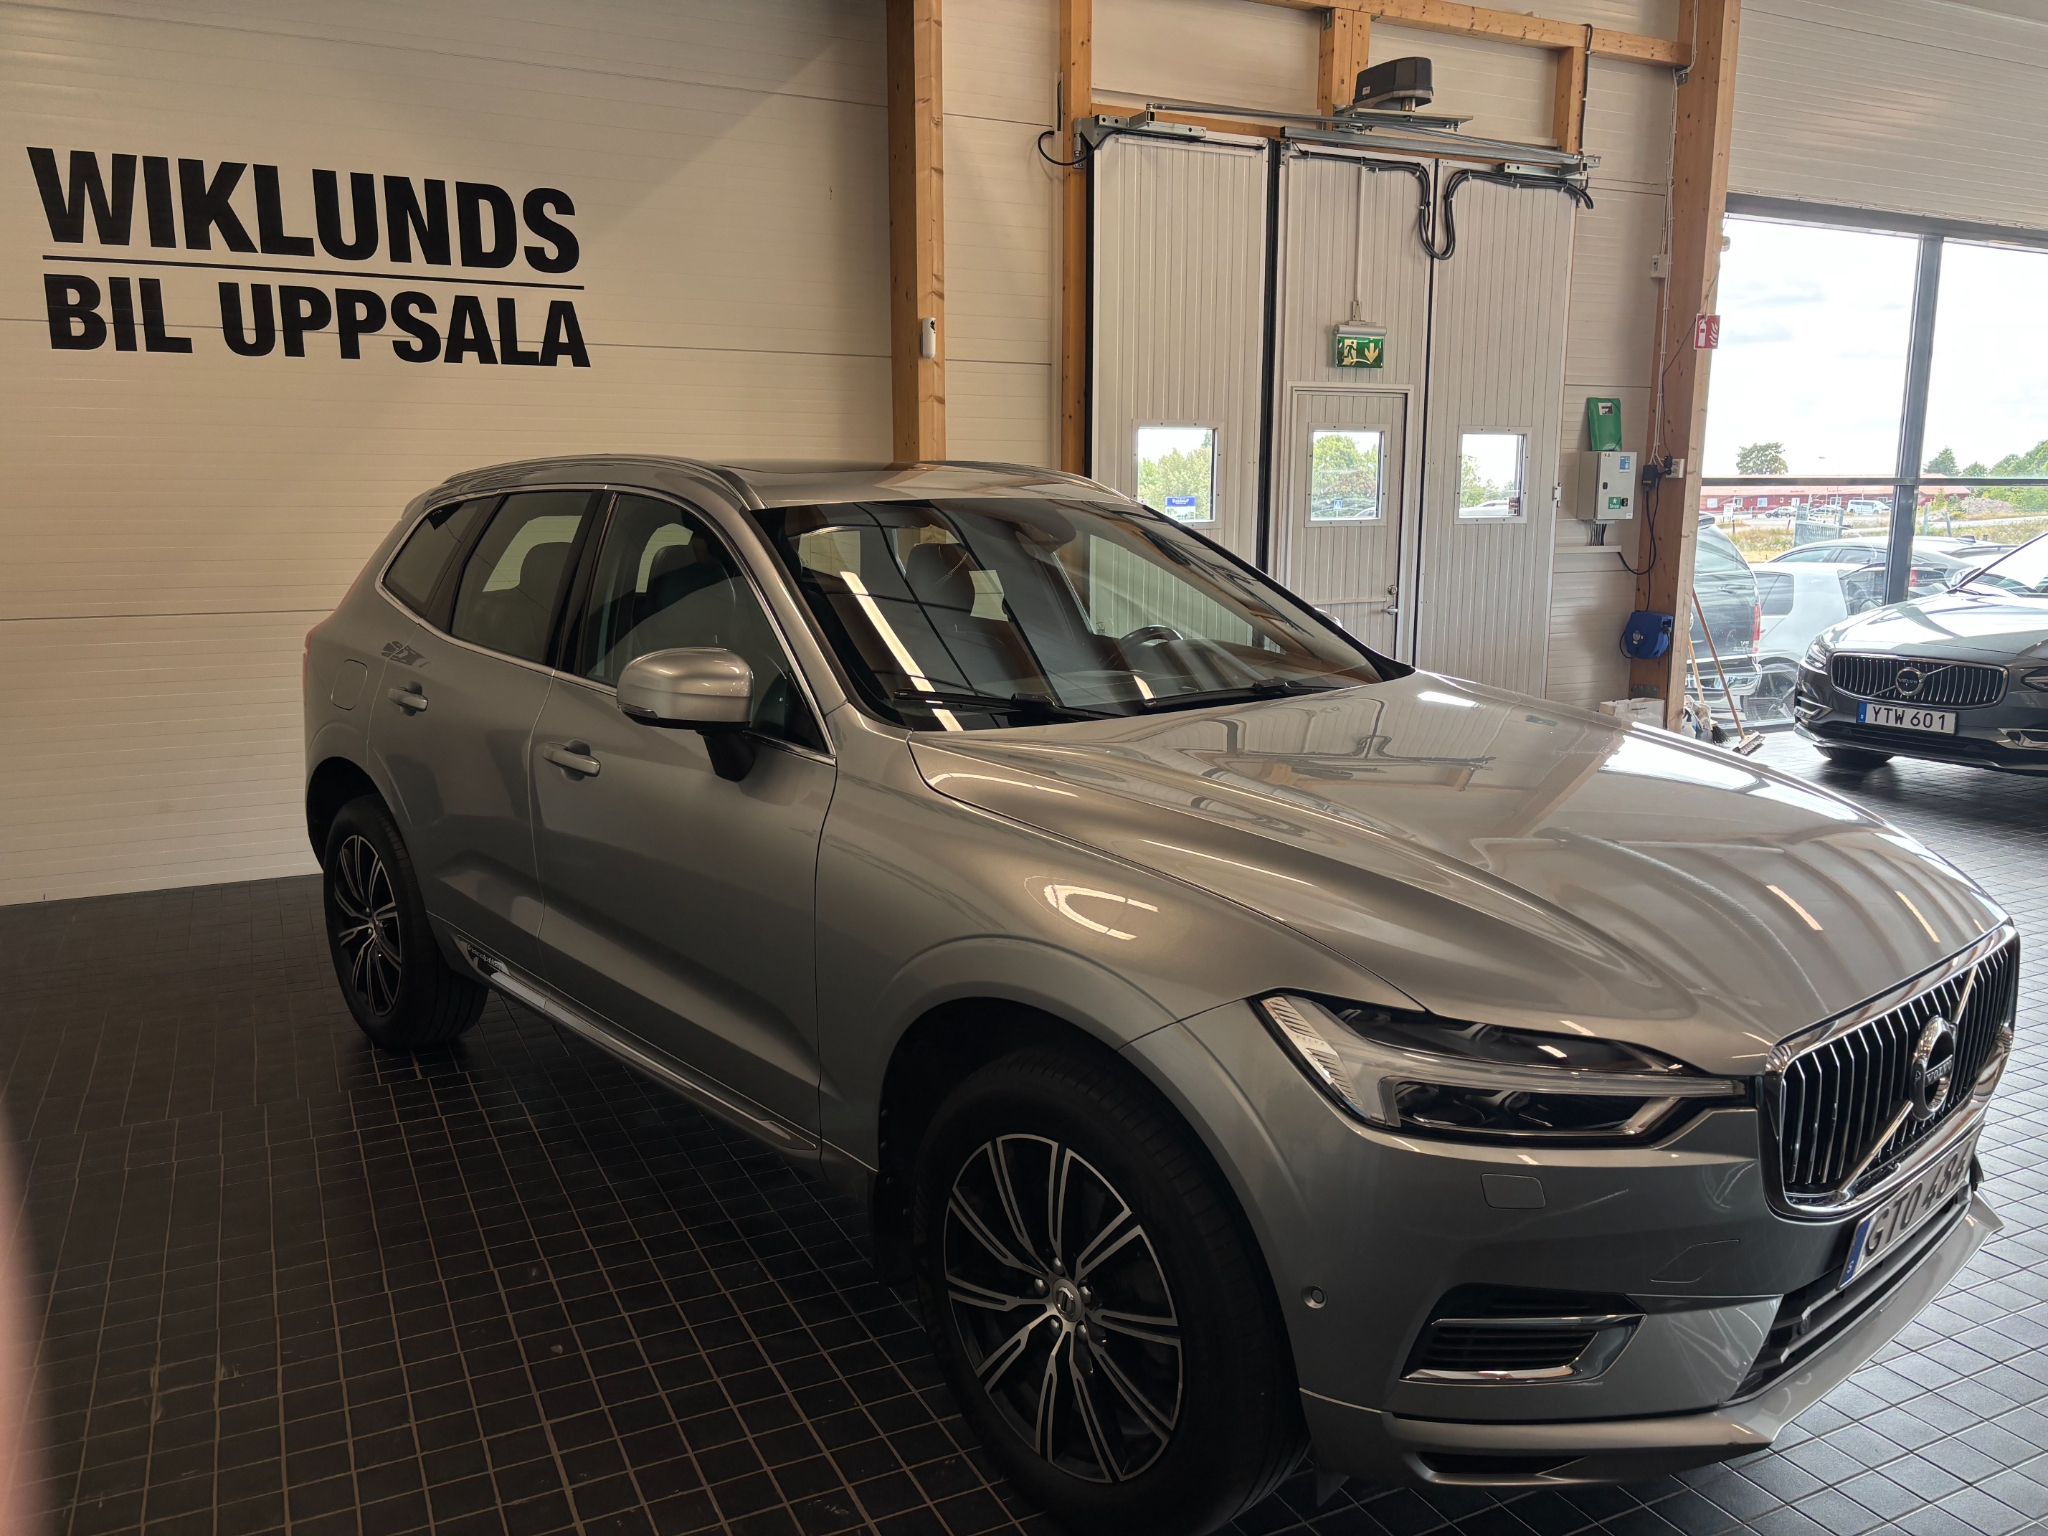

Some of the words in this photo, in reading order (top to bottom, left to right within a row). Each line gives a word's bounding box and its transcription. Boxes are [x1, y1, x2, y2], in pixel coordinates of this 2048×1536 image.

[27, 147, 581, 274] WIKLUNDS
[43, 273, 193, 354] BIL
[218, 281, 591, 368] UPPSALA
[1873, 706, 1906, 726] YTW
[1910, 711, 1946, 730] 601
[1926, 1060, 1953, 1083] VOLVO
[1865, 1181, 1923, 1256] GTO
[1921, 1140, 1973, 1210] 484
